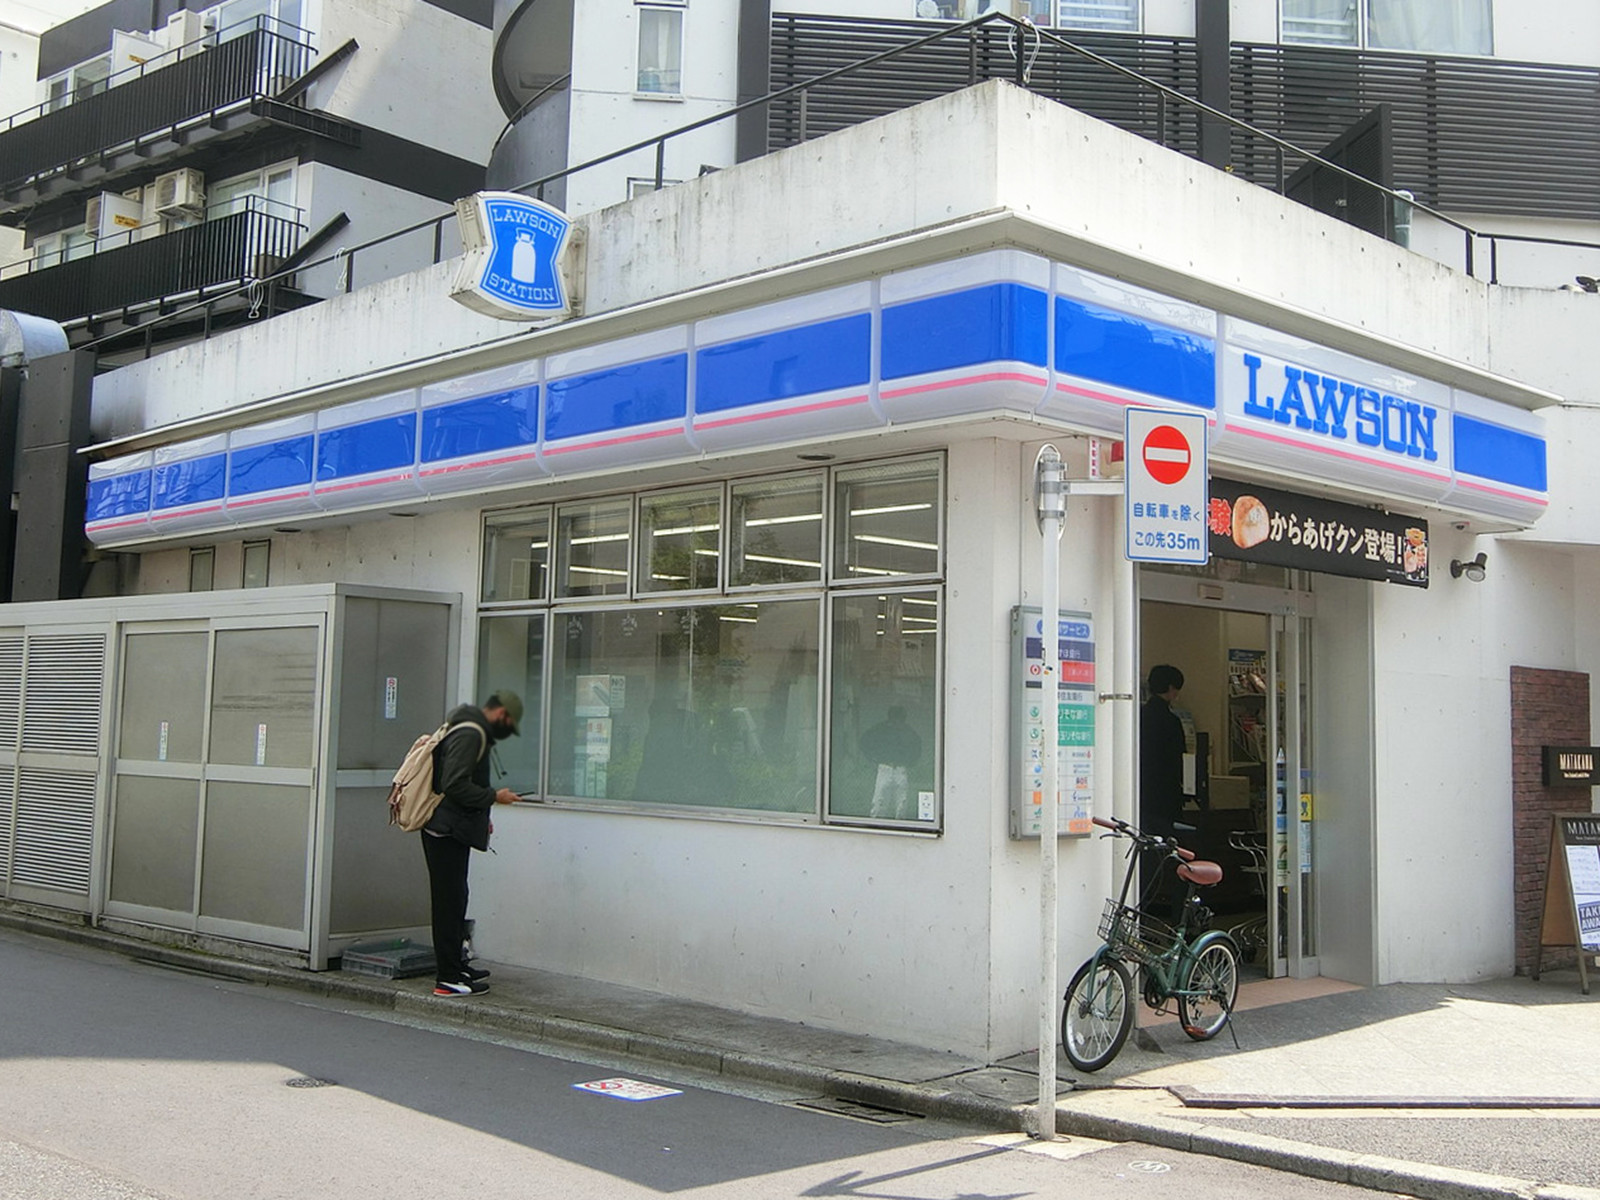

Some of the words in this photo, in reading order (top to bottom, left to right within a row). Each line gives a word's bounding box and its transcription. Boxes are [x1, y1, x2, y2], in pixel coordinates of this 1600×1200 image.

[492, 208, 560, 239] LAWSON
[488, 272, 555, 301] STATION
[1243, 353, 1438, 463] LAWSON
[1133, 502, 1200, 521] 自転車を除く
[1134, 531, 1200, 550] この先35m
[1270, 511, 1402, 565] からあげクン登場!
[1059, 623, 1088, 637] サービス
